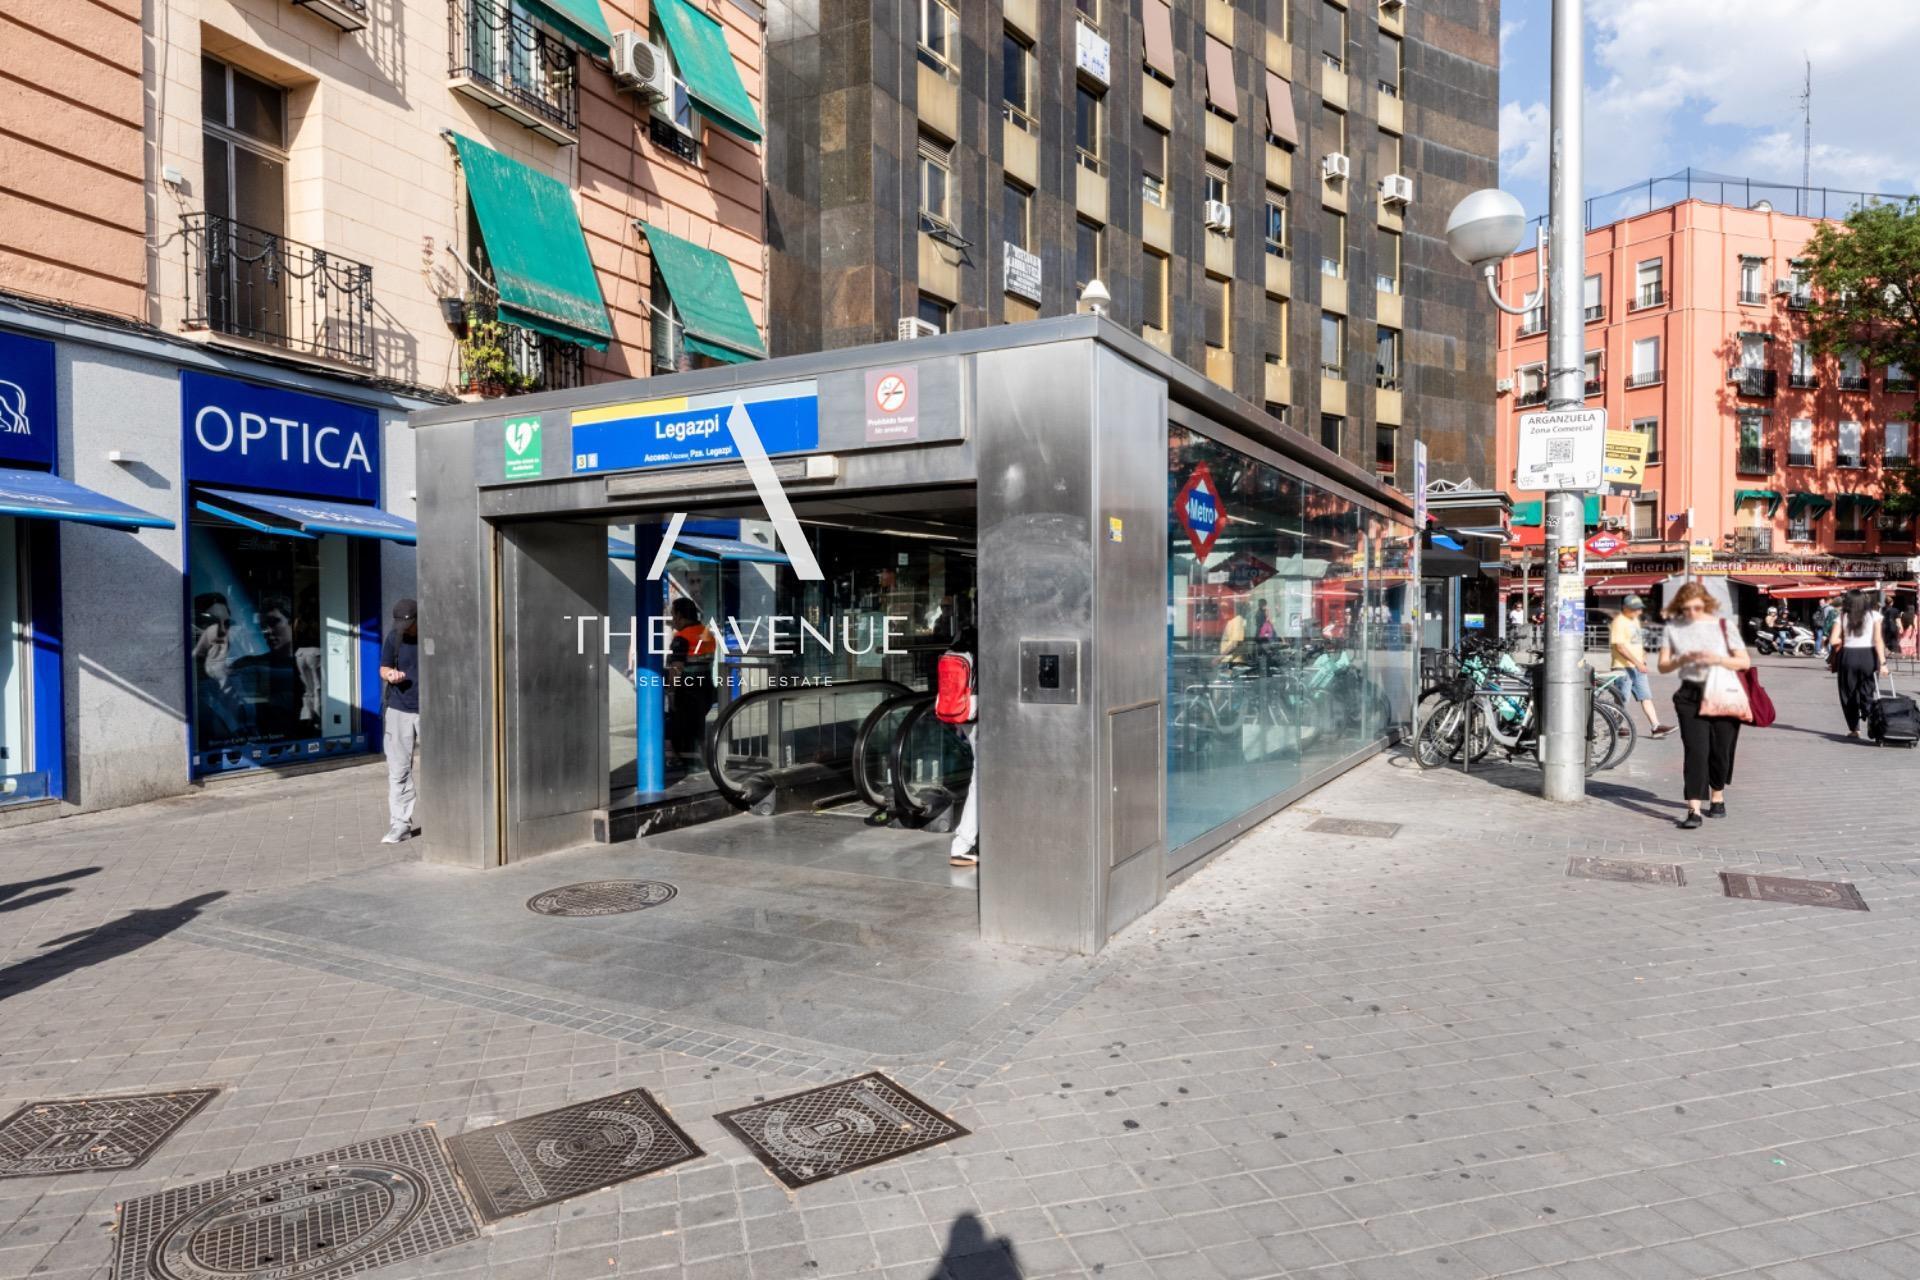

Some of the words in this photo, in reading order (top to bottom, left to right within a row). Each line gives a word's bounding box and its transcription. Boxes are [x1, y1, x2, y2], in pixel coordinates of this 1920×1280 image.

[655, 414, 719, 441] Legazpi
[1528, 413, 1596, 425] ARGANZUELA
[1530, 426, 1551, 434] Zona
[1552, 424, 1593, 433] Comercial
[195, 405, 373, 473] OPTICA
[706, 445, 732, 457] Legazpi
[1190, 497, 1215, 525] Metro
